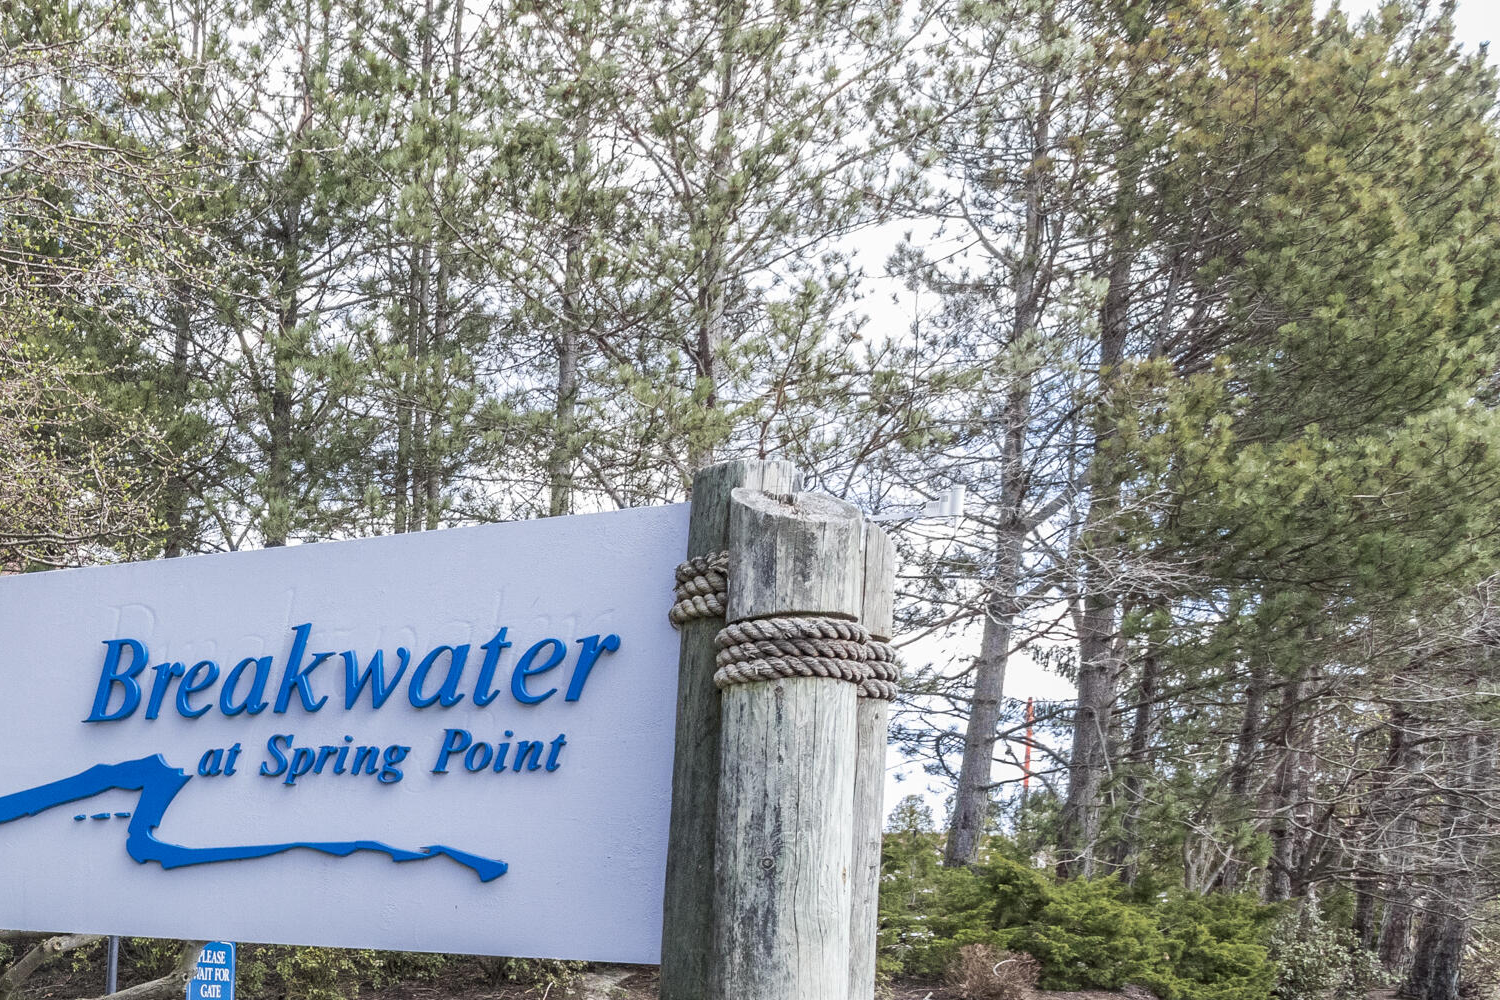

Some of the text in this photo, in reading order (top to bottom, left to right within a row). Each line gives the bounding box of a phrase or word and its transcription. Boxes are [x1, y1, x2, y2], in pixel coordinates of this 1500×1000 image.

[82, 622, 621, 724] Breakwater
[197, 727, 568, 786] at Spring Point
[198, 949, 226, 964] PLEASE
[214, 967, 230, 982] FOR
[200, 984, 222, 998] GATE
